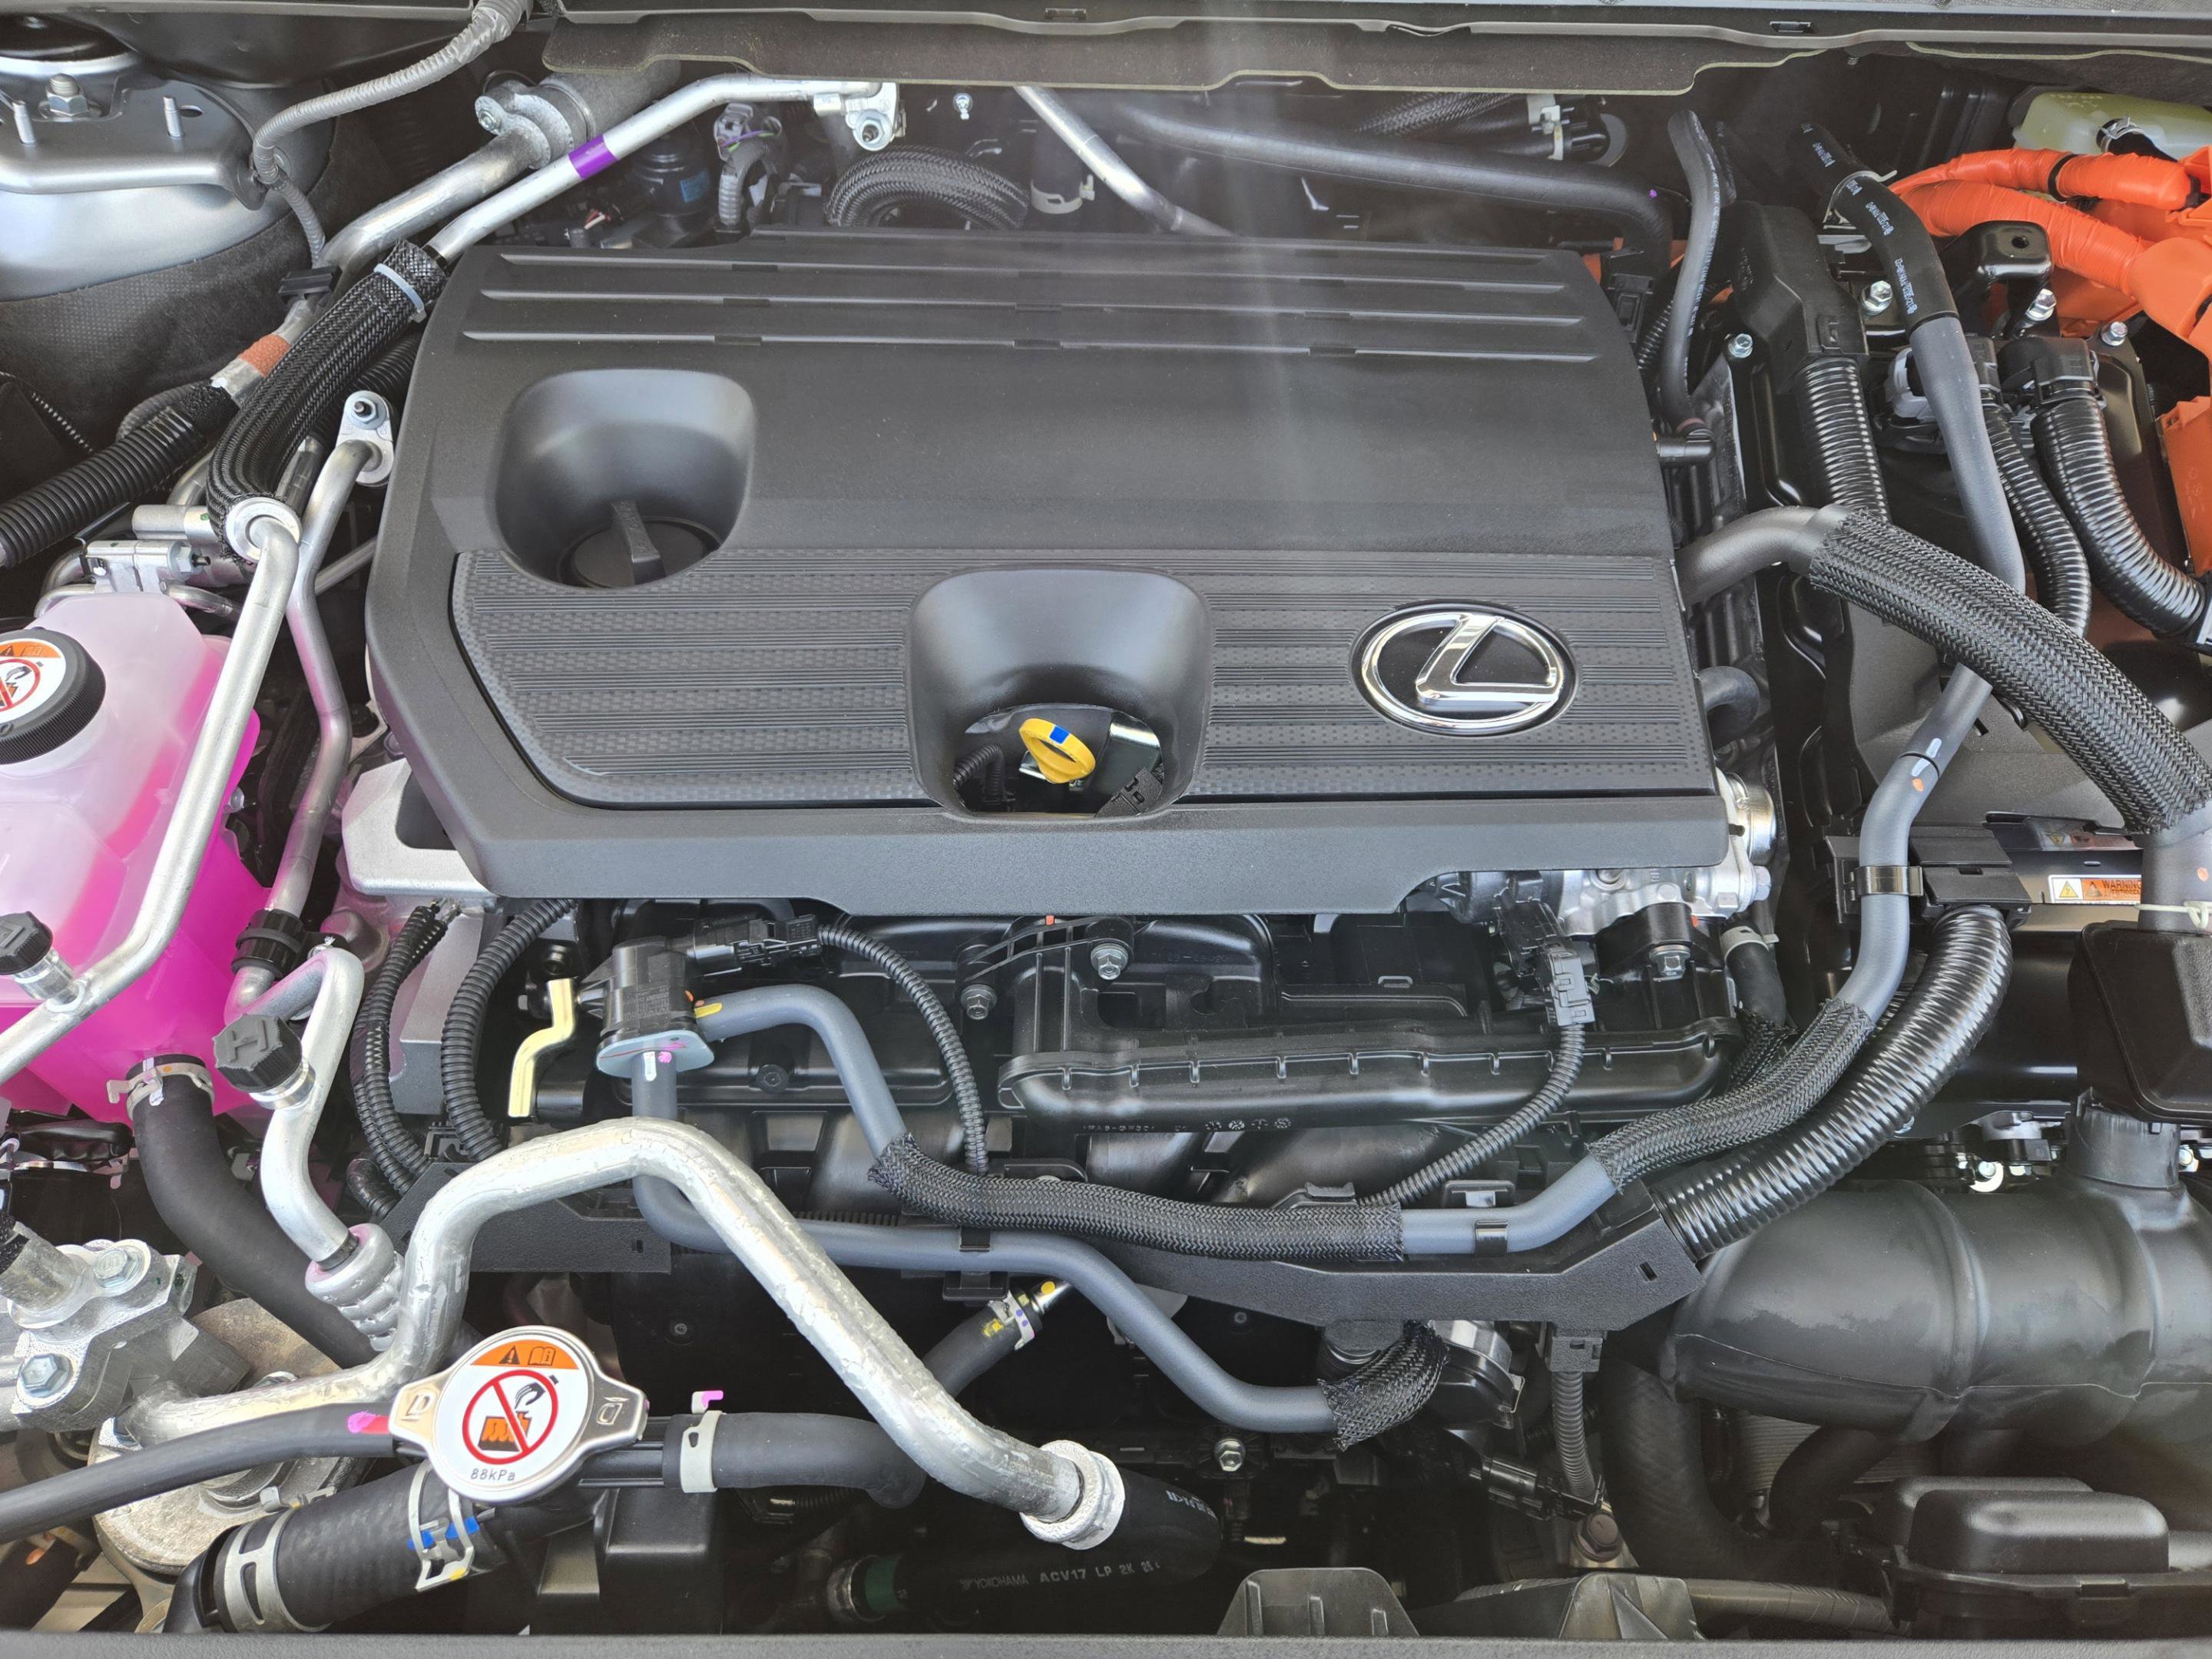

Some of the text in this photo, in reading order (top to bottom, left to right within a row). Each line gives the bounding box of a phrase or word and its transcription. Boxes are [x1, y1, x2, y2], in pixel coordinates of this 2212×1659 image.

[2101, 879, 2141, 889] WARNING
[470, 1468, 516, 1482] 88kPa
[973, 1575, 1030, 1589] YOKOHAMA
[1039, 1568, 1086, 1583] ACV17
[1095, 1566, 1113, 1578] LP
